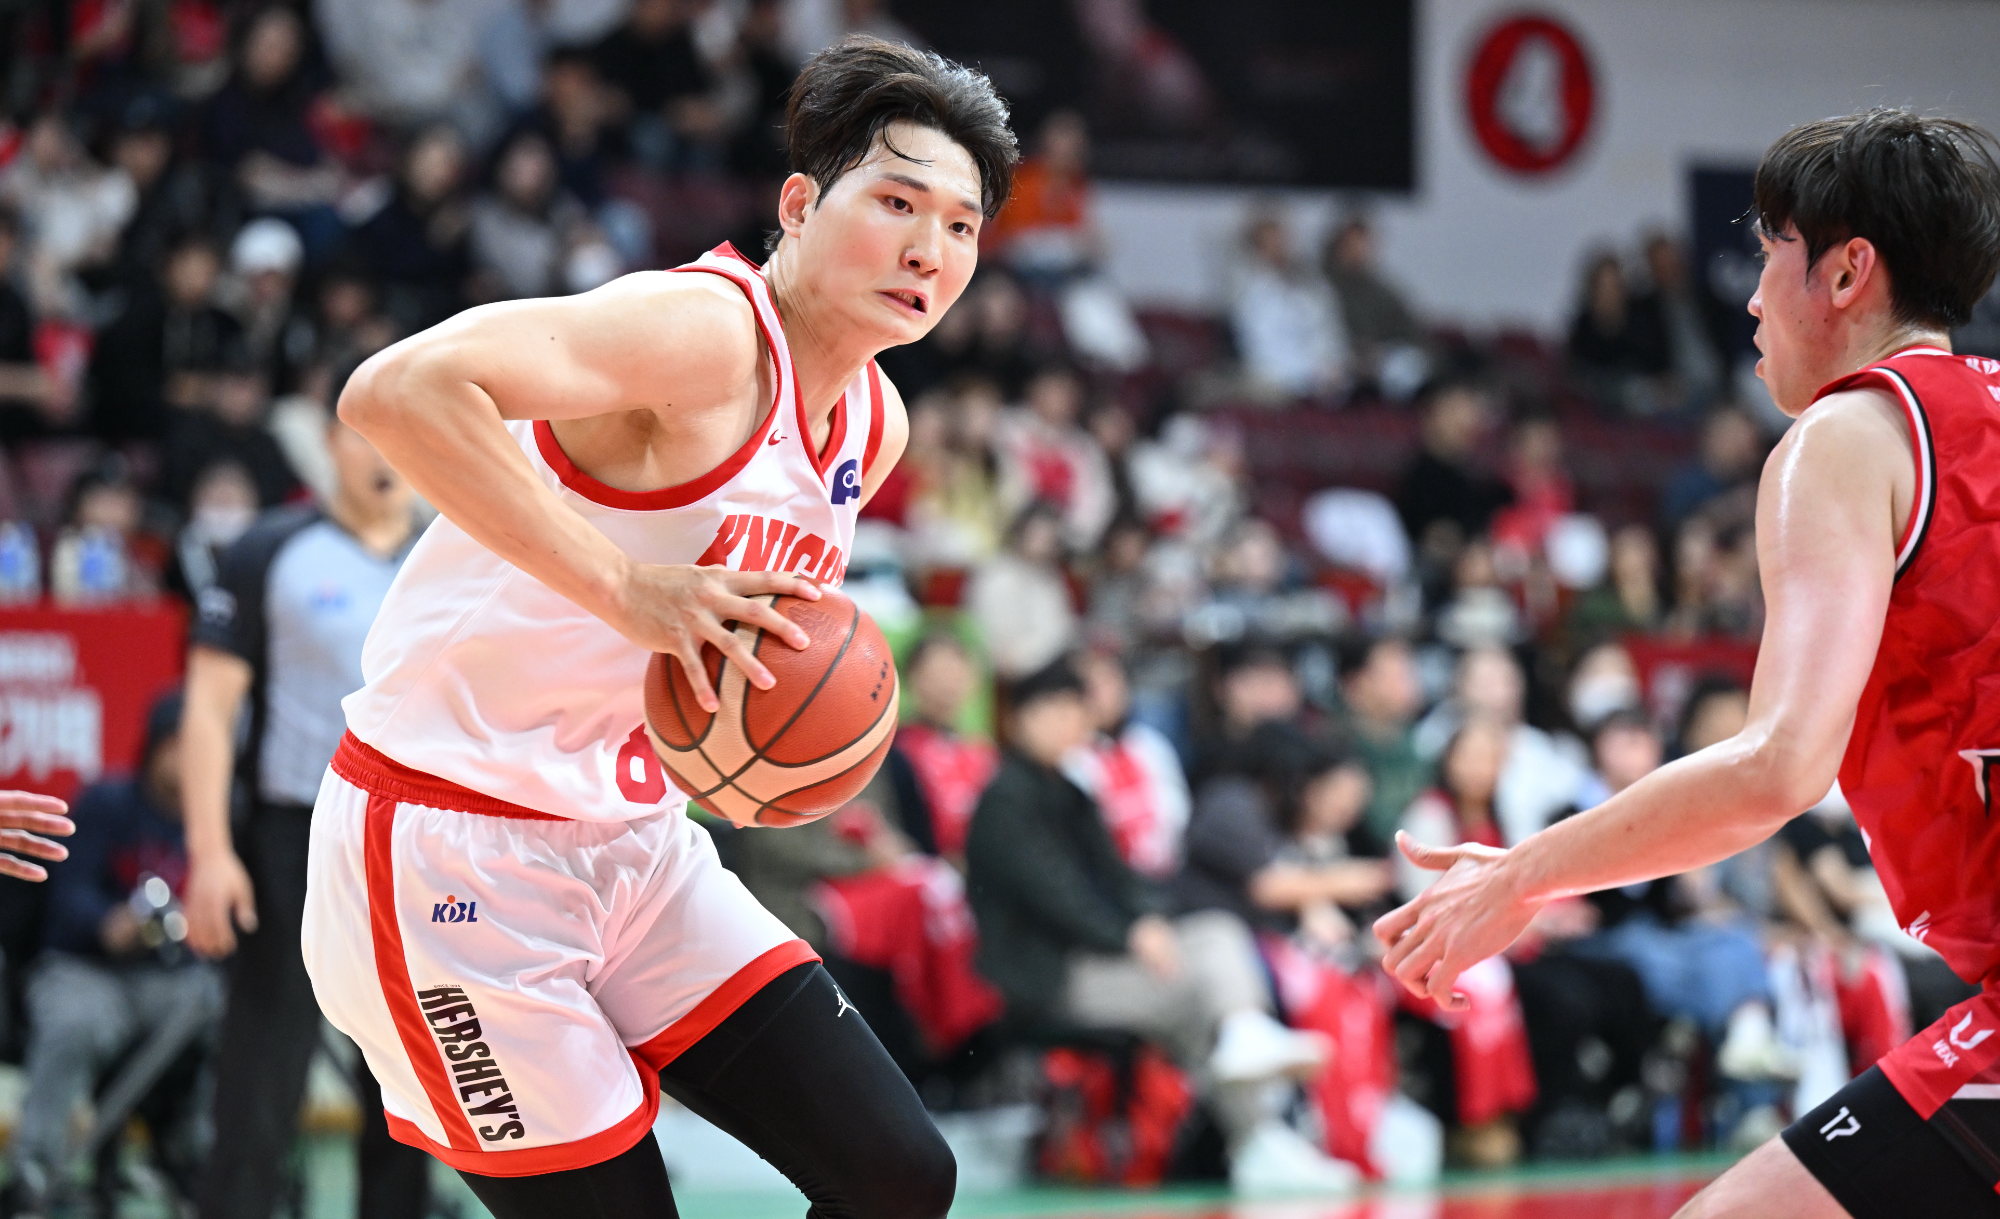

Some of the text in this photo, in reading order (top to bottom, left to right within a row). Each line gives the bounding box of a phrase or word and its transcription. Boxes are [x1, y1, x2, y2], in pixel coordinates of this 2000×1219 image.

[431, 901, 478, 923] KBL
[417, 987, 525, 1142] HERSHEY'S
[1819, 1105, 1862, 1142] 17
